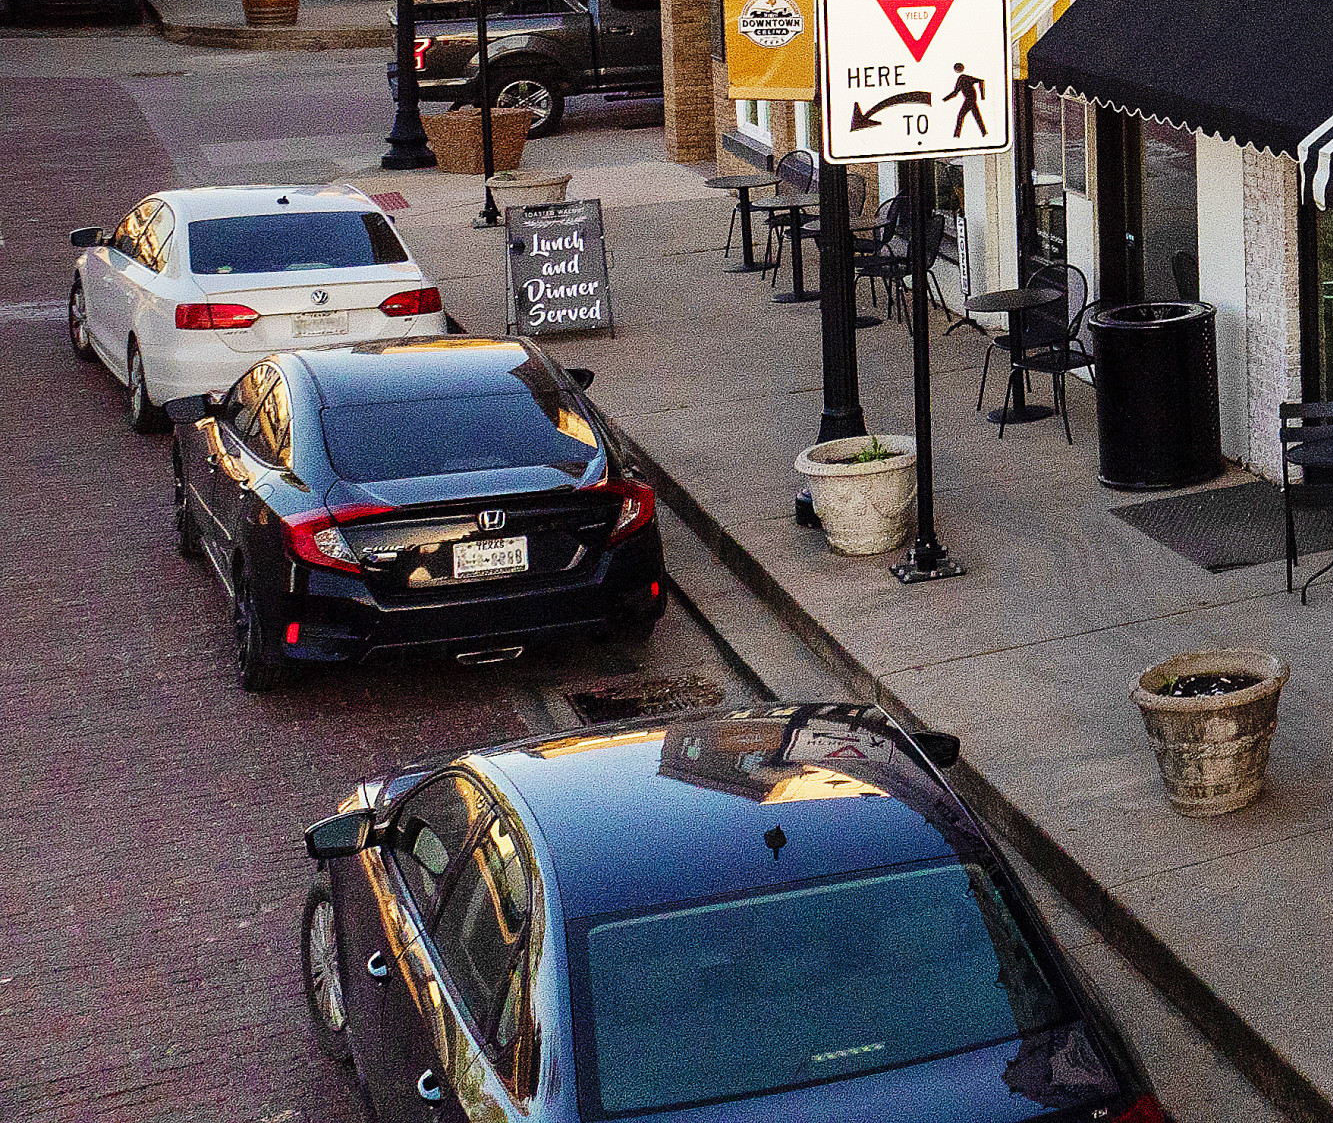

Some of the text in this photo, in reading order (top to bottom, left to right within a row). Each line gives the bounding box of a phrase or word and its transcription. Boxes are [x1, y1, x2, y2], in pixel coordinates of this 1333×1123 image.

[742, 19, 801, 27] DOWNTOWN
[905, 11, 929, 20] YIELD
[847, 65, 906, 89] HERE
[902, 114, 929, 135] TO
[530, 230, 585, 256] Lunch
[542, 254, 580, 275] and
[522, 278, 600, 302] Dinner
[529, 299, 601, 327] Served
[476, 539, 505, 551] TEXAS
